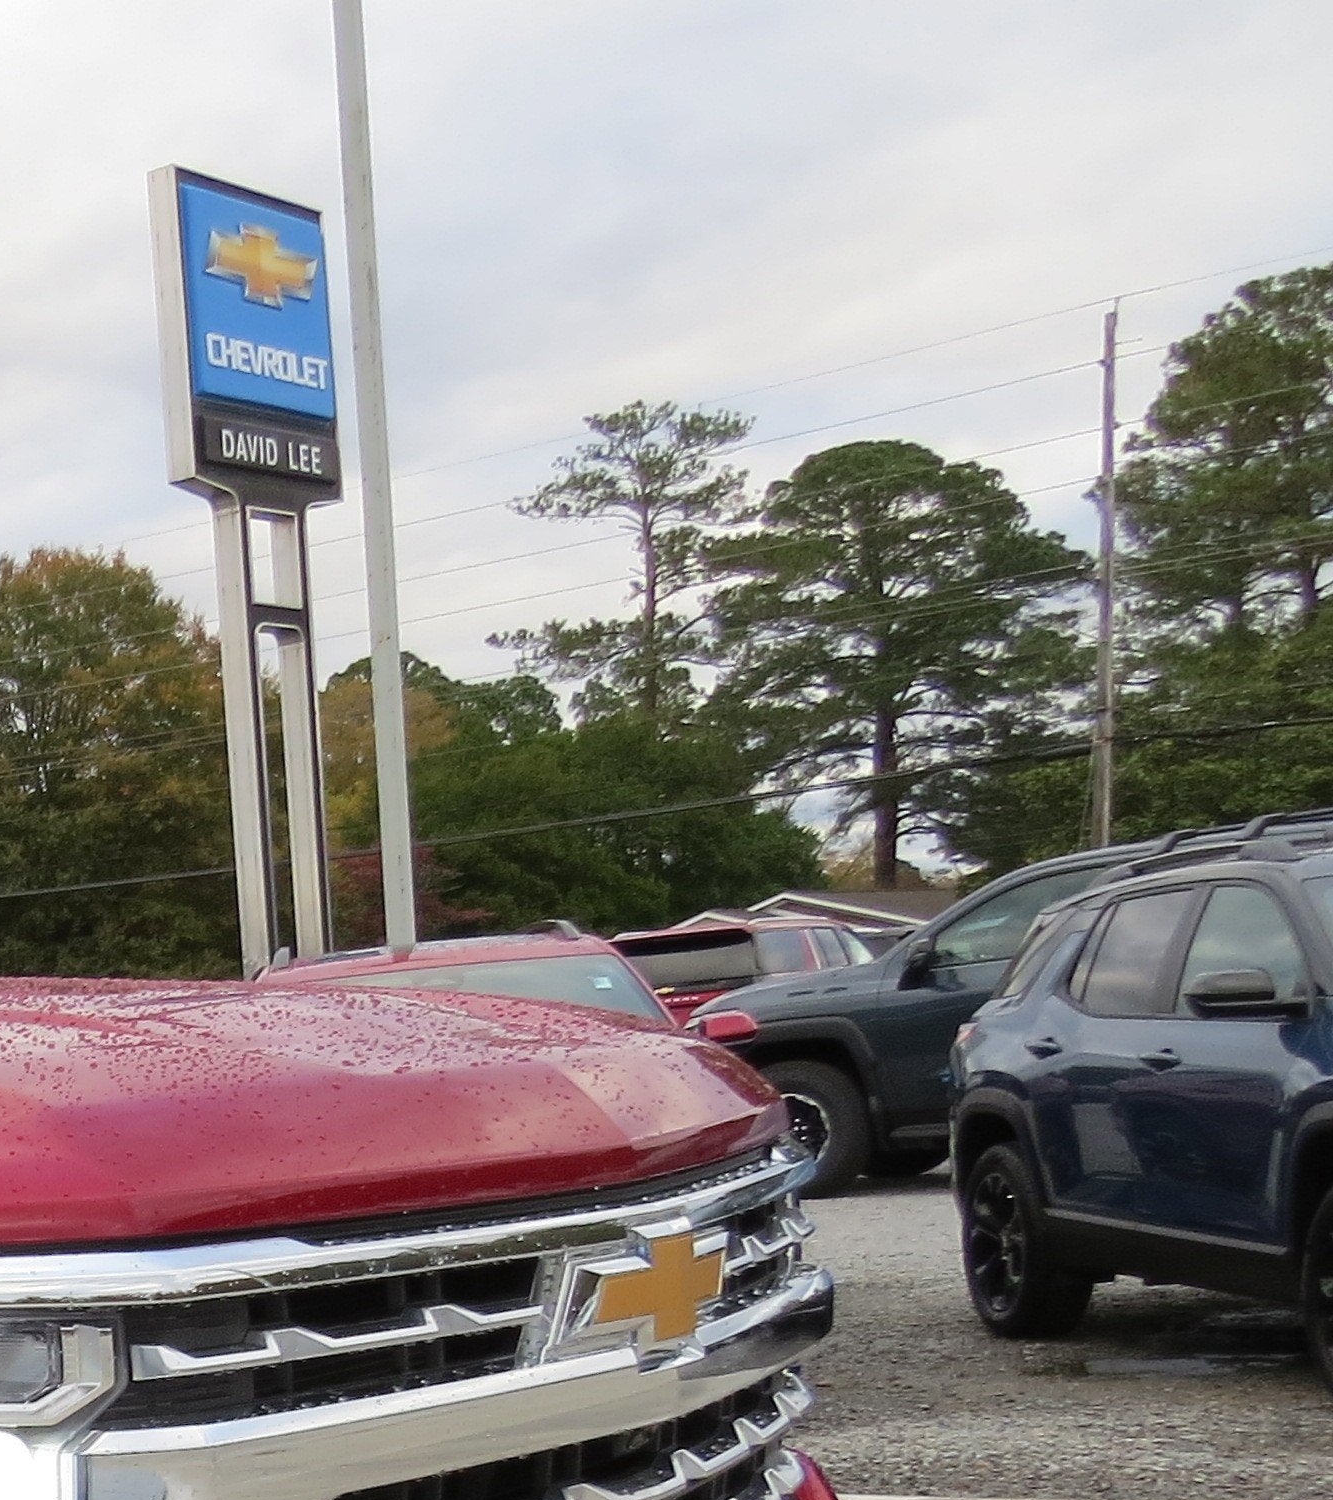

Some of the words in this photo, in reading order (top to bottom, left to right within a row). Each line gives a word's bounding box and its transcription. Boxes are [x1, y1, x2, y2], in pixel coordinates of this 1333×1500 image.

[205, 332, 328, 391] CHEVROLET
[221, 429, 278, 467] DAVID
[287, 440, 323, 475] LEE
